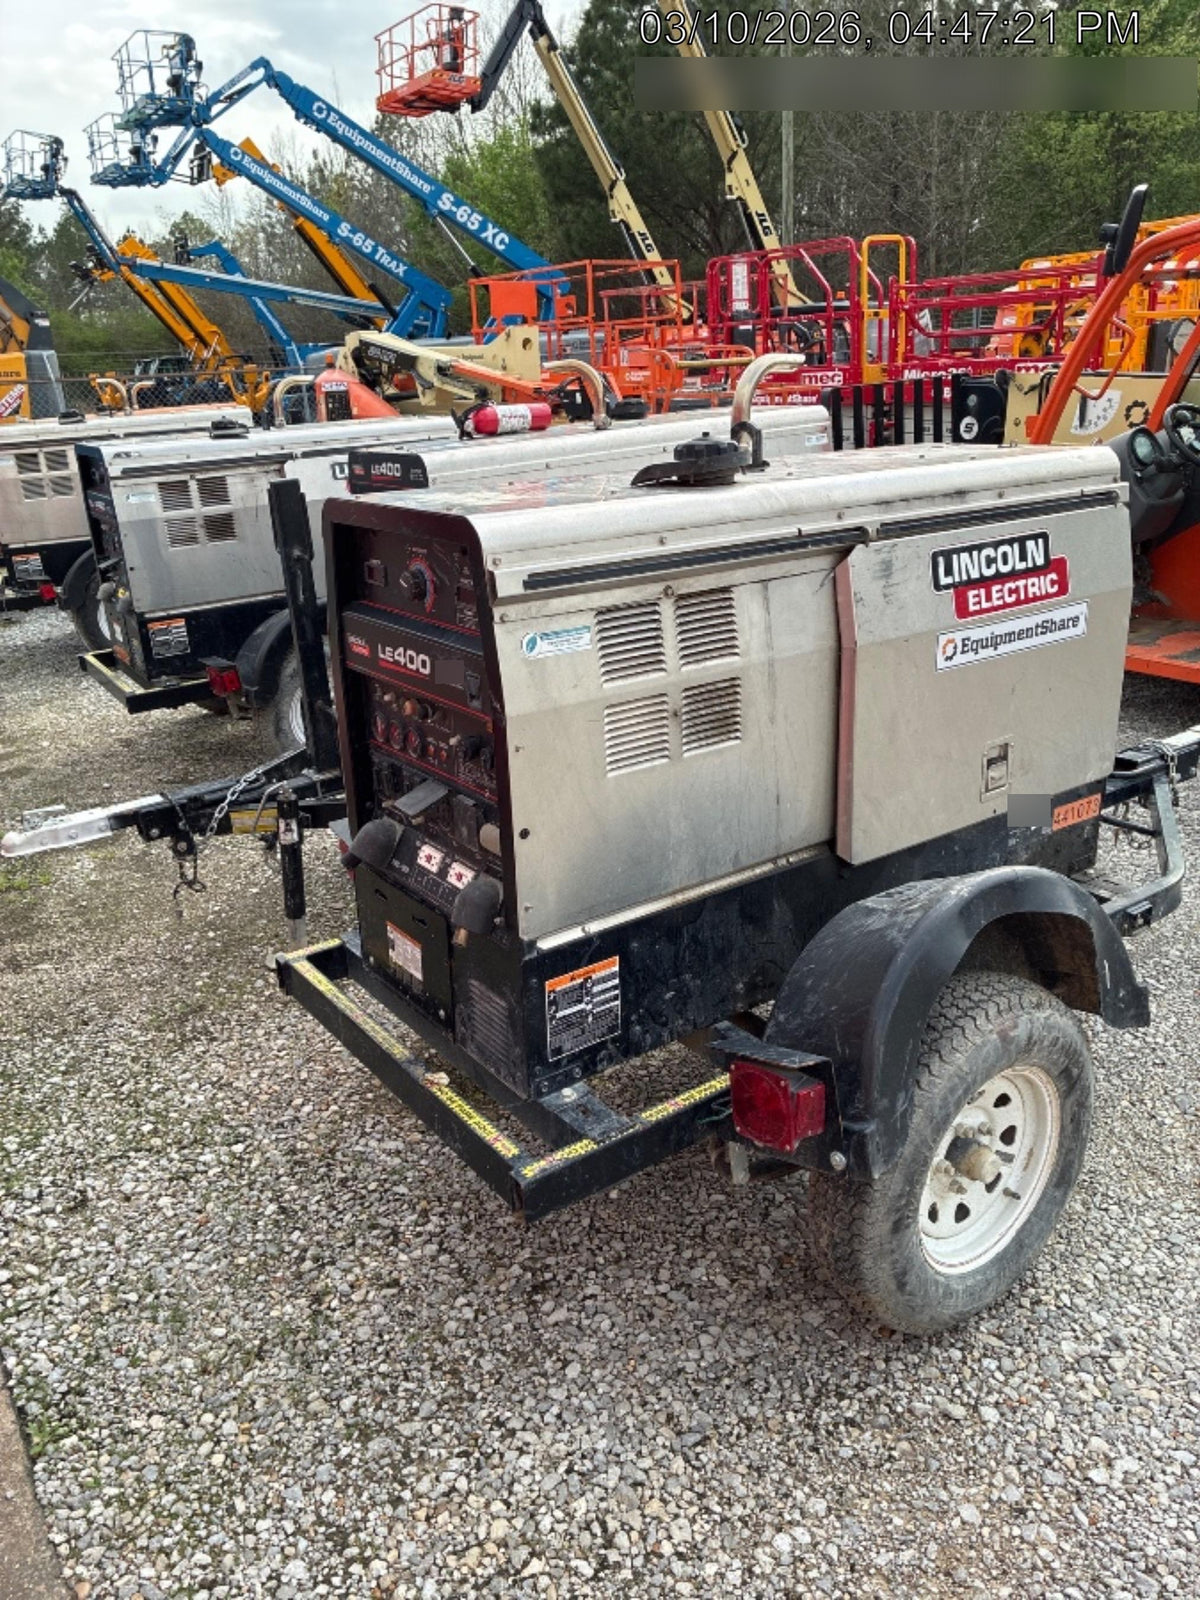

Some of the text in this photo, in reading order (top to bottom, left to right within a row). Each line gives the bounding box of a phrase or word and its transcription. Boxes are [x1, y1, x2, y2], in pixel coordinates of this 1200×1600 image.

[326, 112, 510, 251] EquipmentShare S-65 XC
[242, 155, 330, 222] EquipmentShare
[337, 221, 373, 252] S-65
[756, 211, 773, 237] JLG
[637, 230, 655, 253] JLG
[803, 372, 841, 384] mec
[371, 462, 401, 477] LE400
[938, 539, 1045, 585] LINCOLN
[967, 573, 1058, 611] ELECTRIC
[960, 614, 1081, 655] EquipmentShare
[378, 643, 431, 674] LE400
